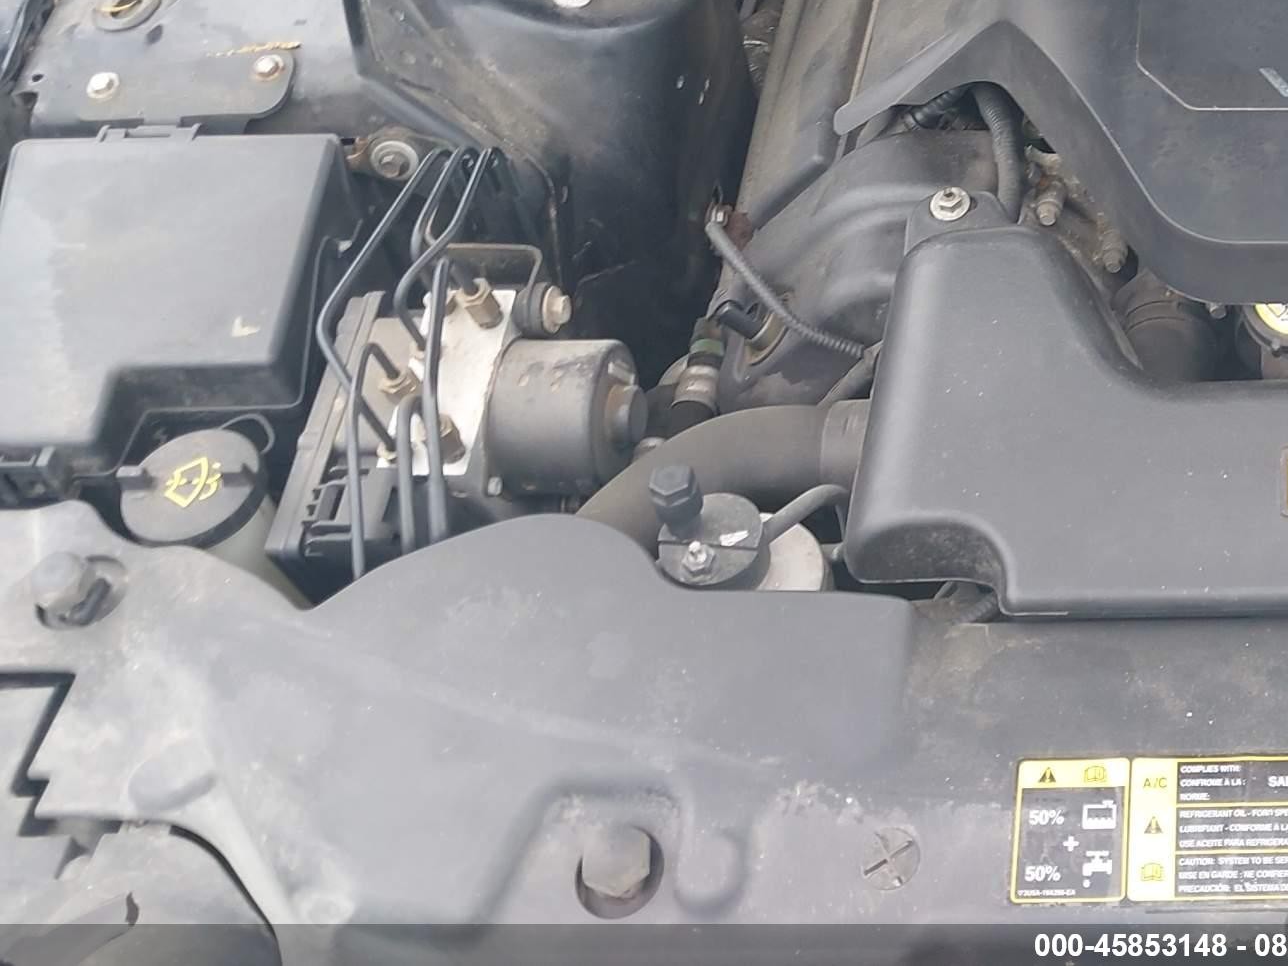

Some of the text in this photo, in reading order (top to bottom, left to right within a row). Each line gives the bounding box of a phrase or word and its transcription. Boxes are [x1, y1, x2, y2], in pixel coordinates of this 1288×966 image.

[1180, 765, 1219, 773] COMPLIES
[1143, 778, 1168, 788] A/C
[1029, 810, 1065, 825] 50%
[1180, 809, 1232, 818] REFRIGERANT
[1233, 808, 1247, 817] OIL
[1217, 857, 1250, 865] SYSTEM
[1250, 856, 1262, 865] TO
[1262, 856, 1273, 864] BE
[1024, 865, 1061, 881] 50%
